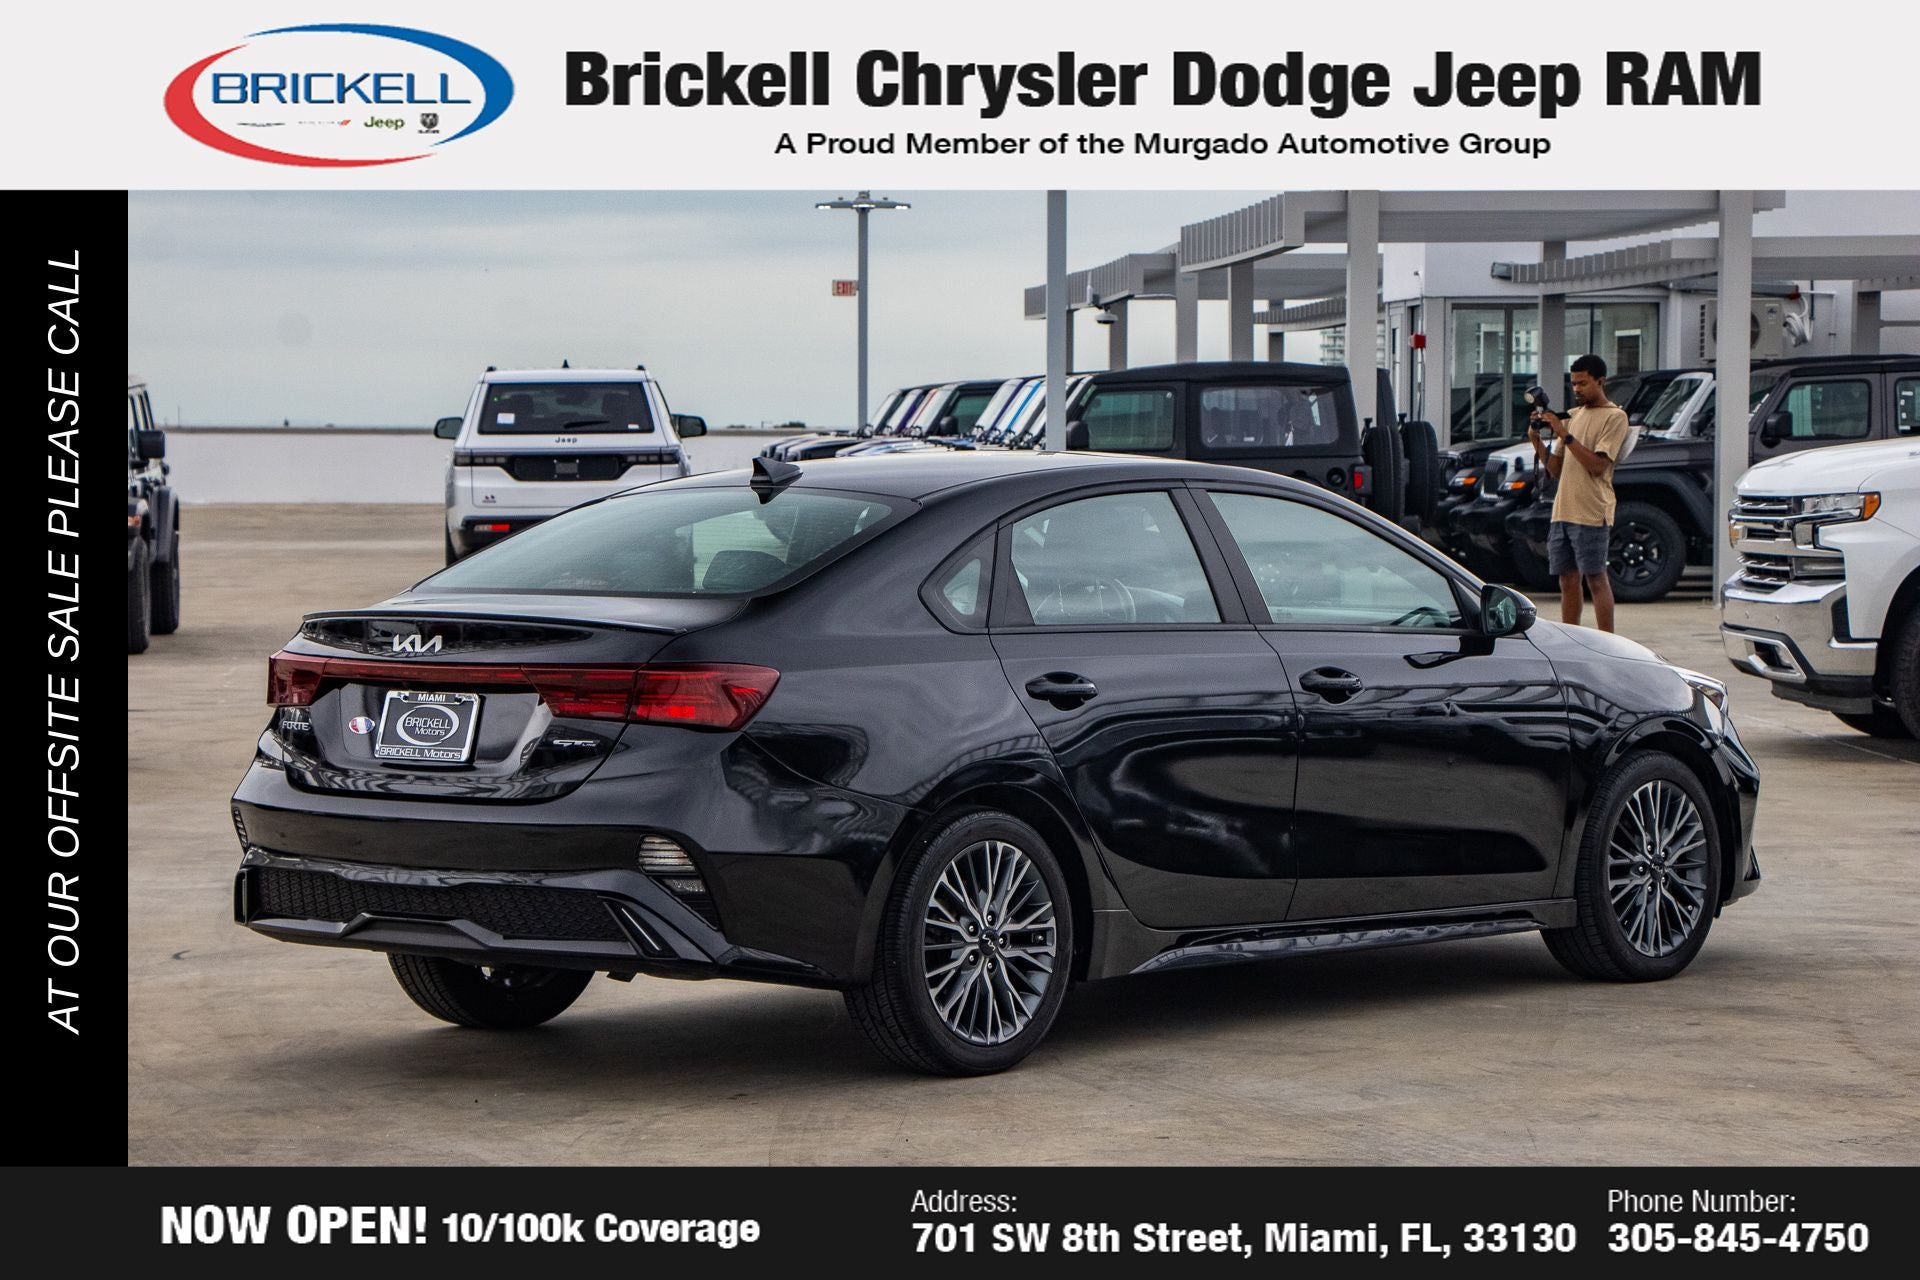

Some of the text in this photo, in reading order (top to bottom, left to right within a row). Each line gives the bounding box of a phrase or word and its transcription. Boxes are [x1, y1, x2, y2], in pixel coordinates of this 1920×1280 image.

[393, 634, 442, 653] KIA
[418, 694, 445, 702] MIAMI
[282, 720, 309, 731] FORTE
[405, 716, 451, 729] BRICKELL
[415, 727, 445, 736] Motors
[380, 747, 461, 759] BRICKELL Motors
